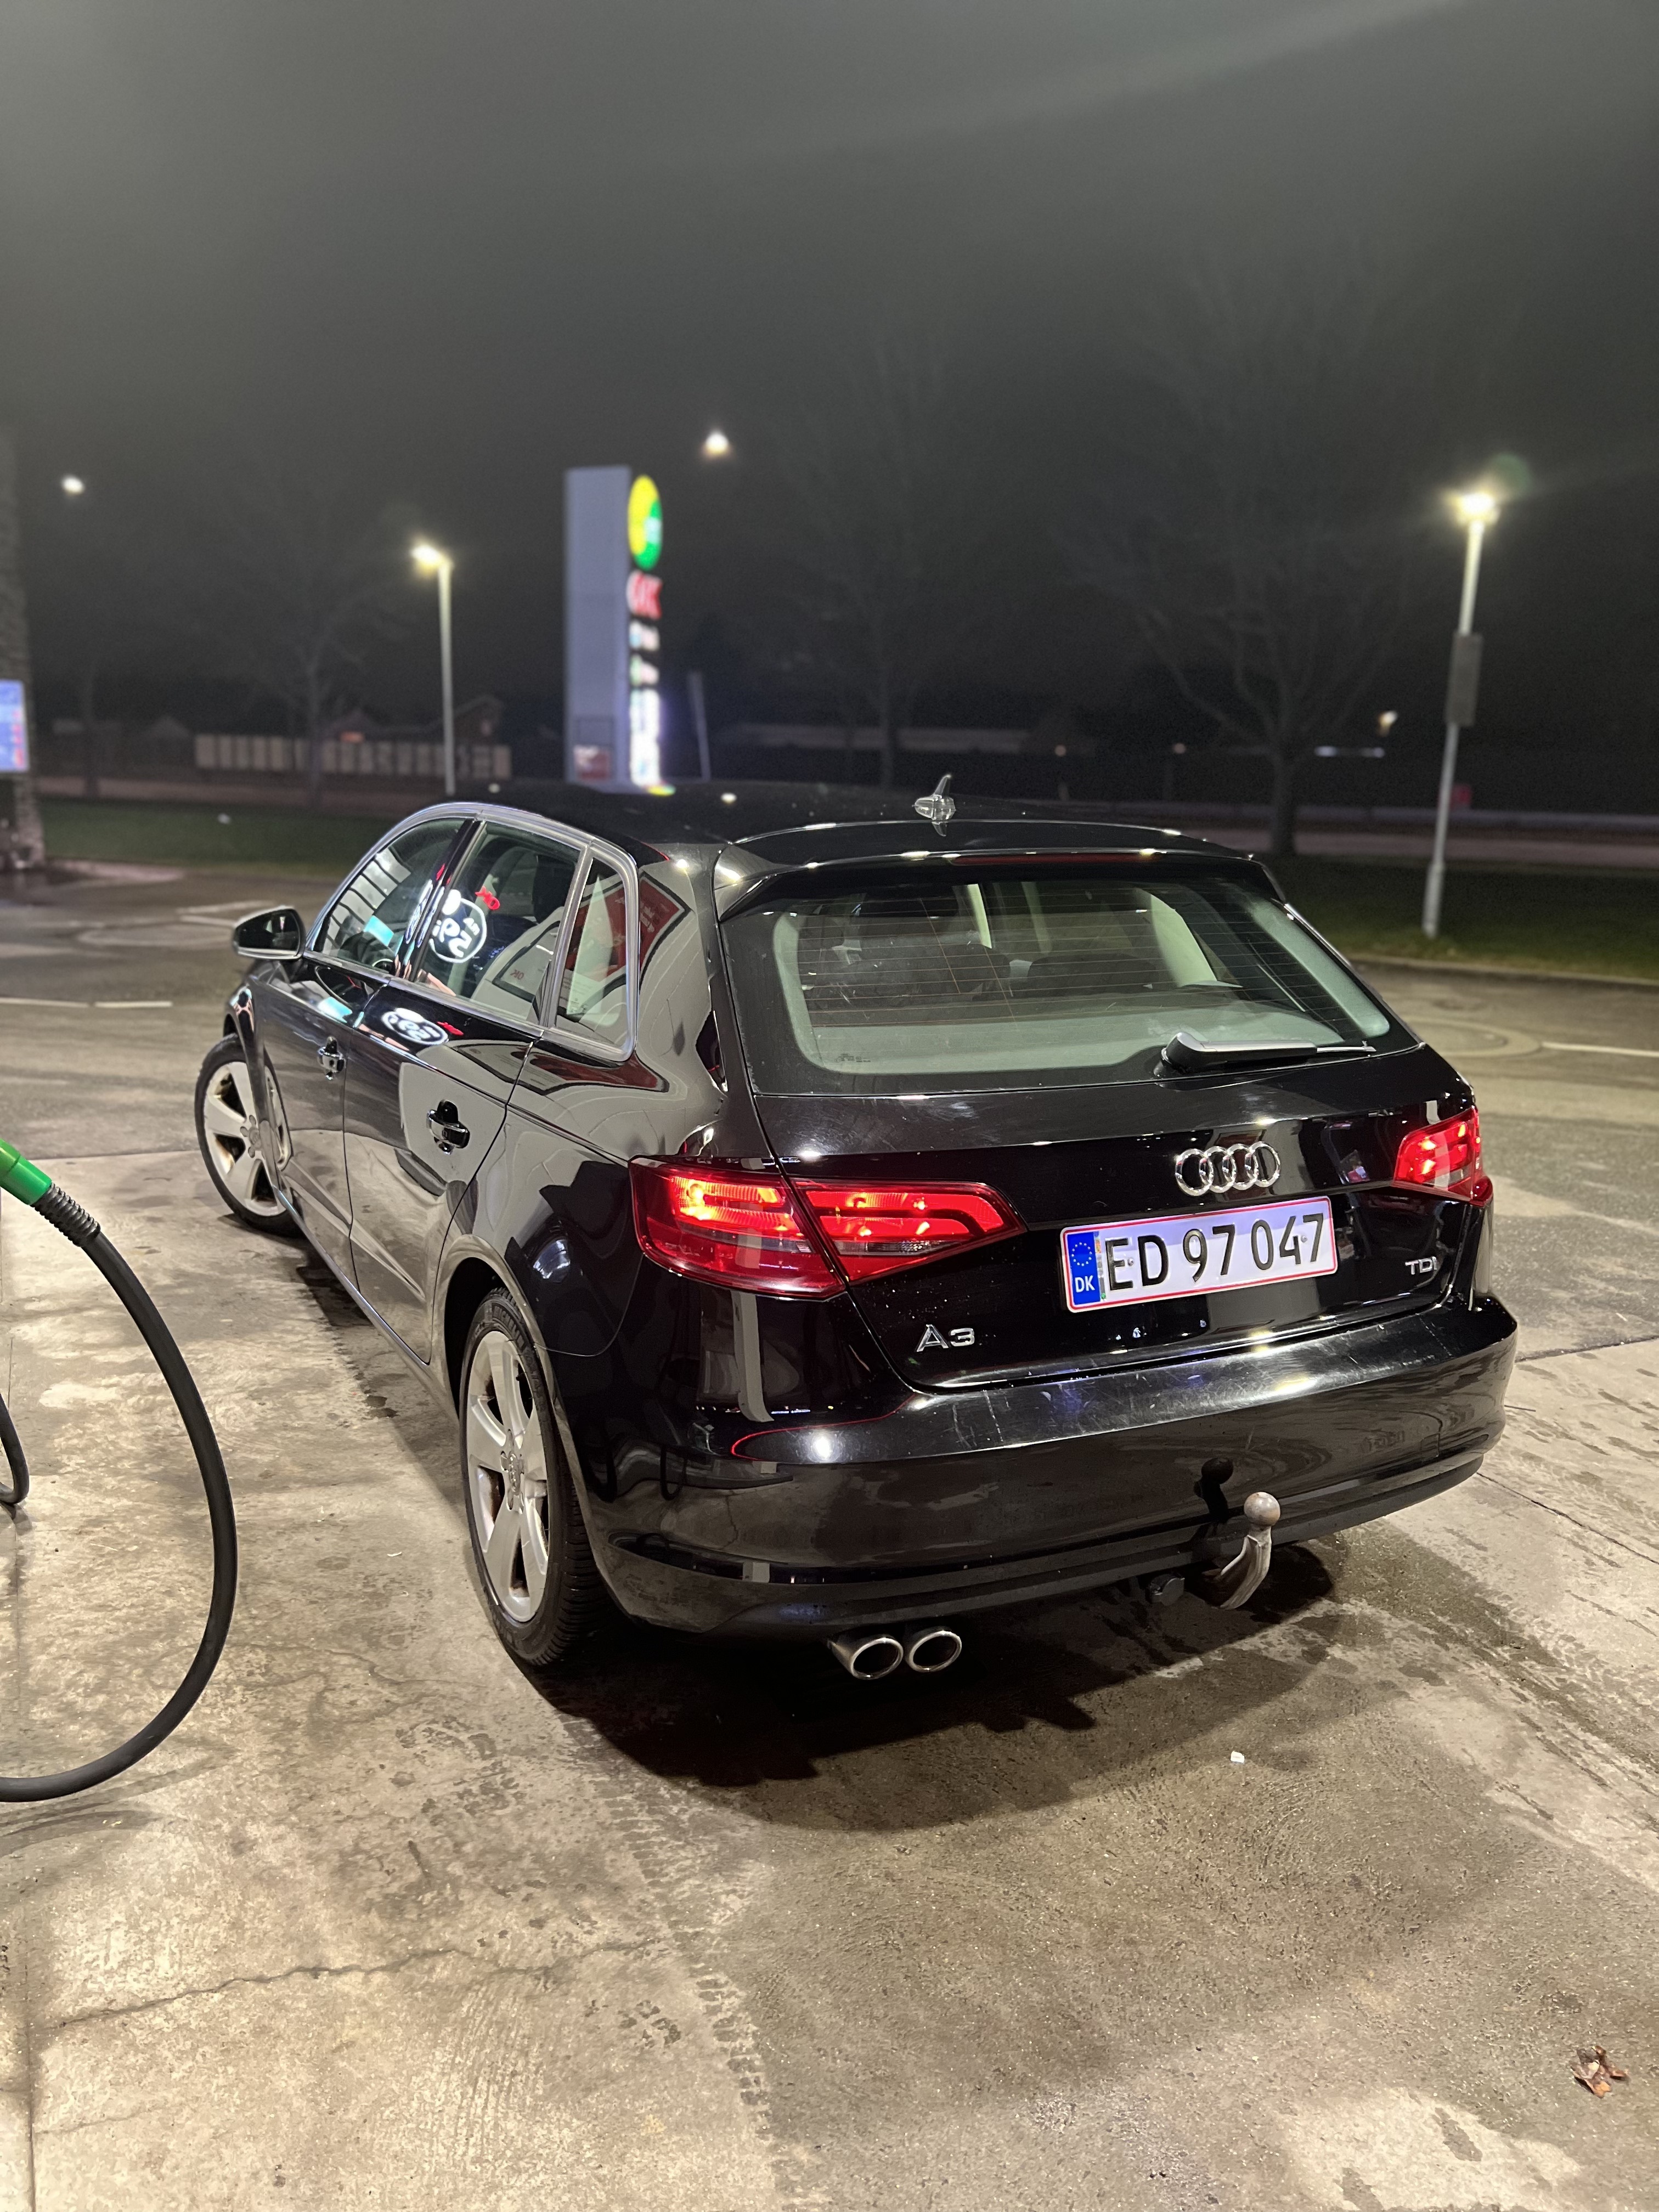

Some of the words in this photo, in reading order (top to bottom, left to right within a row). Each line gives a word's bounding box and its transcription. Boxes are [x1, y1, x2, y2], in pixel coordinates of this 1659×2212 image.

[1104, 1234, 1169, 1291] ED
[1183, 1224, 1235, 1282] 97
[1251, 1213, 1323, 1270] 047
[1075, 1276, 1095, 1293] DK
[916, 1324, 975, 1352] A3
